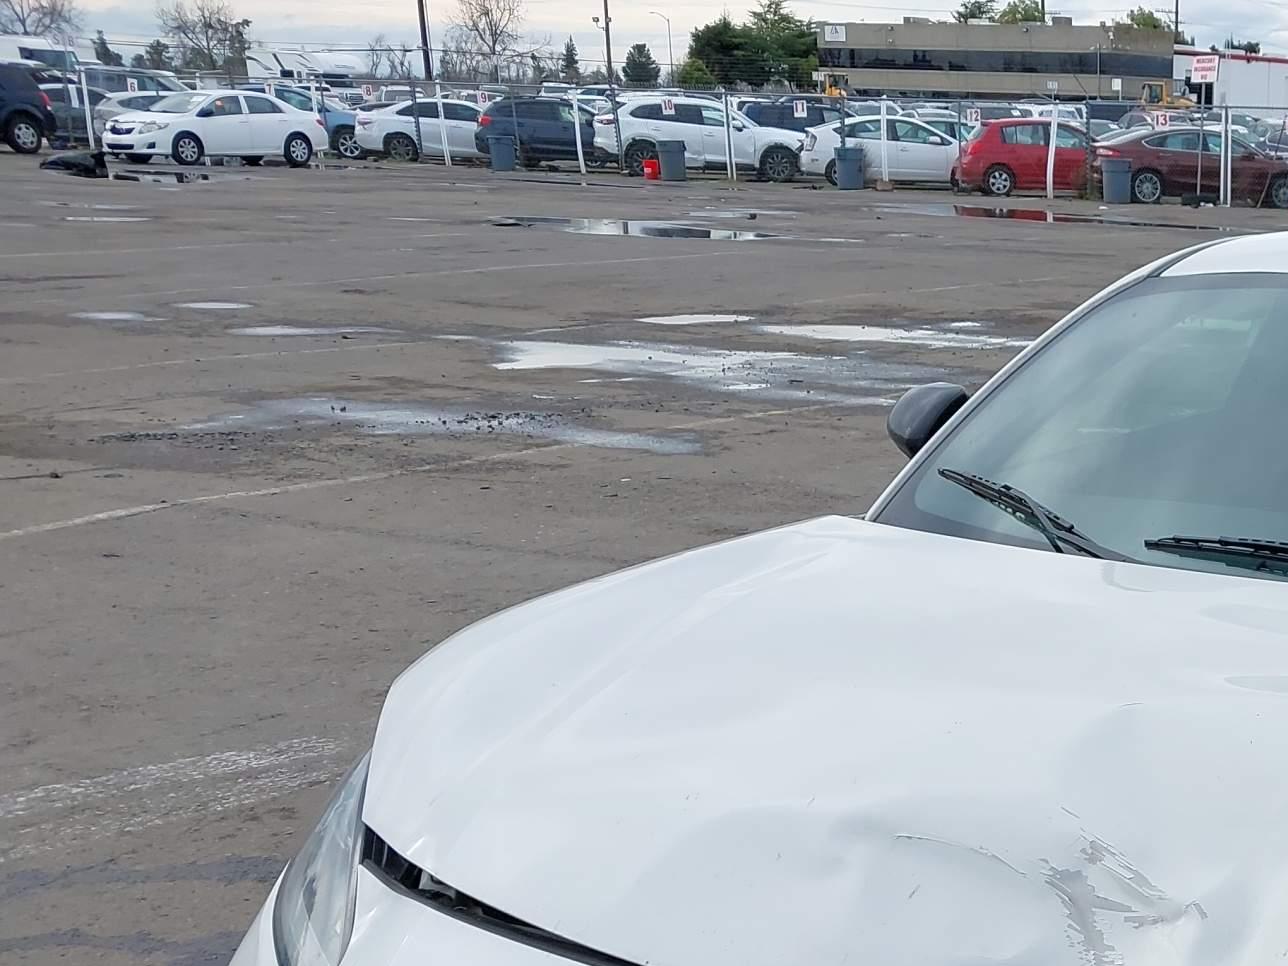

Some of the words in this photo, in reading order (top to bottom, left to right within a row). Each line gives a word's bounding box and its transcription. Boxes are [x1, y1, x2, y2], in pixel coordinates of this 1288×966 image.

[130, 82, 136, 92] 6
[480, 92, 487, 103] 9
[664, 100, 673, 110] 10
[795, 102, 805, 112] 11
[969, 110, 980, 122] 12
[1156, 114, 1168, 126] 13
